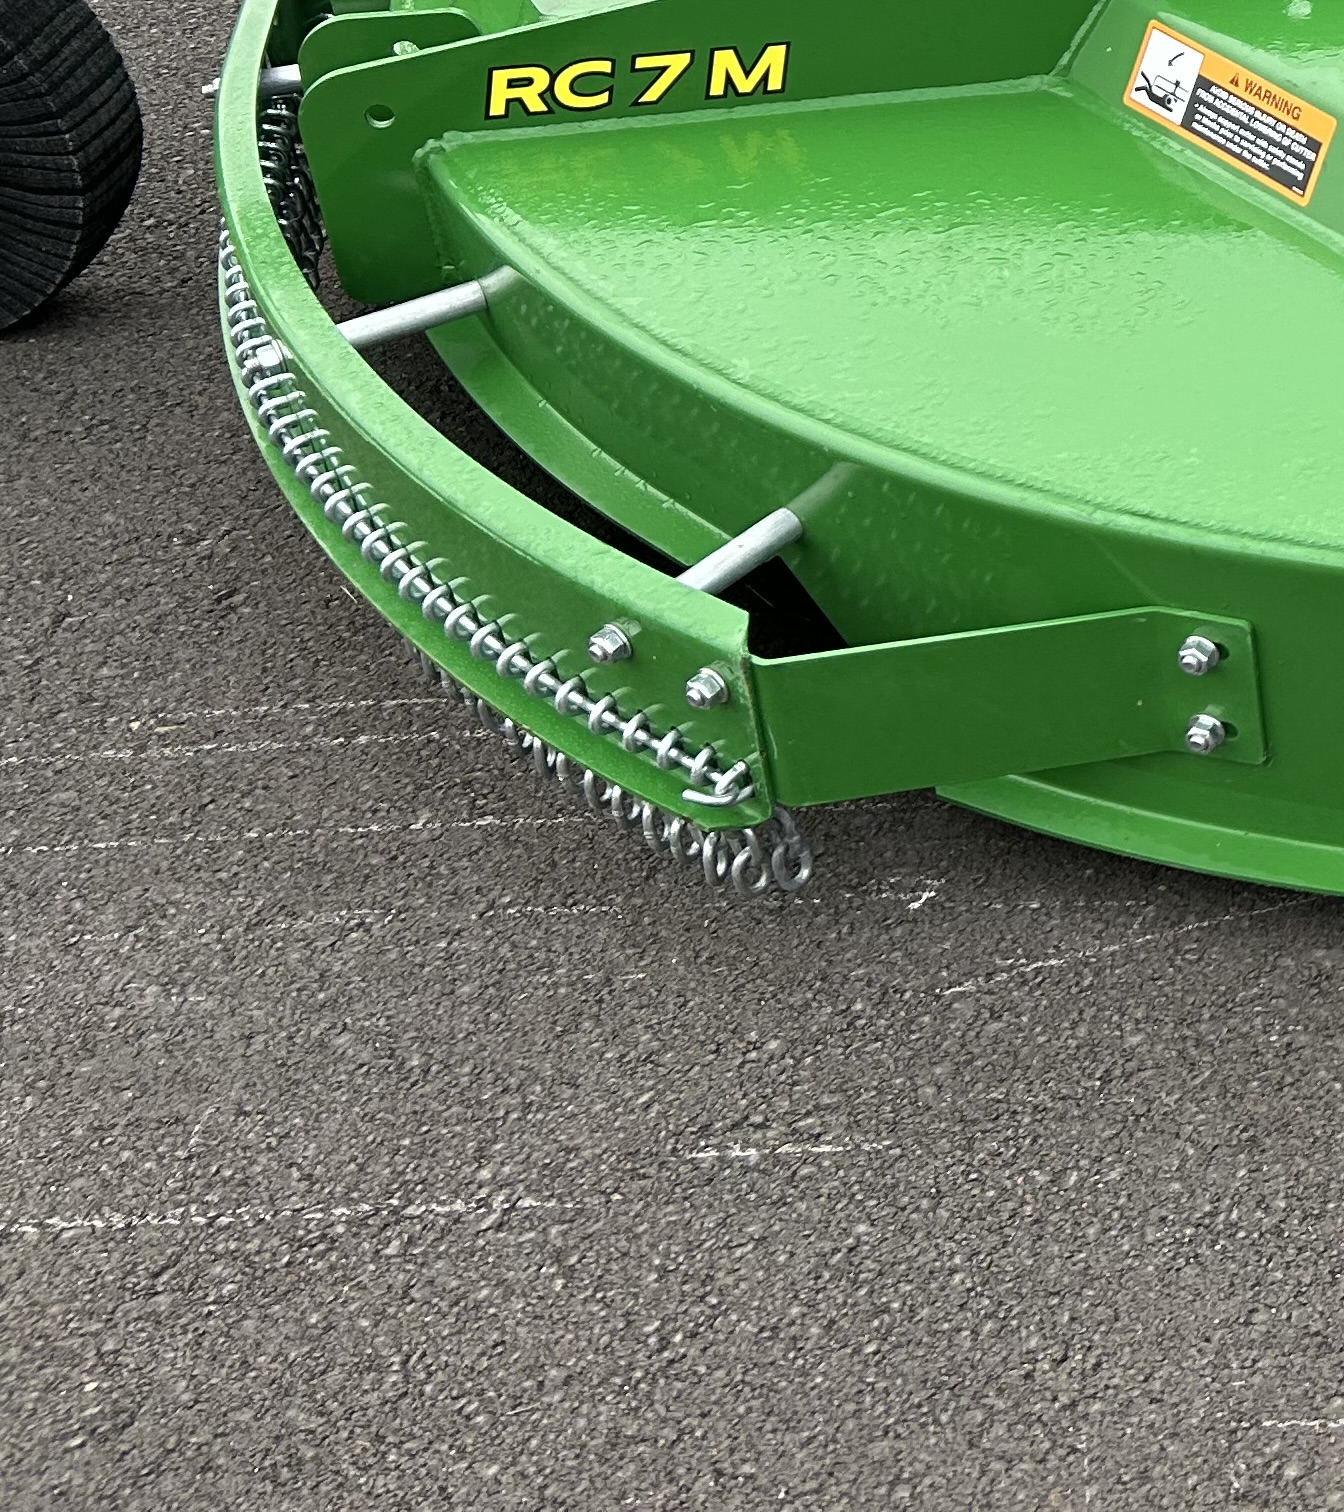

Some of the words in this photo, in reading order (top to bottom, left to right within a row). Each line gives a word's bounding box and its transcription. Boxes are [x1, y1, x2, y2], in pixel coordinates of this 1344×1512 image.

[486, 58, 615, 120] RC
[630, 50, 694, 106] 7
[705, 42, 790, 100] M
[1244, 77, 1302, 122] WARNING
